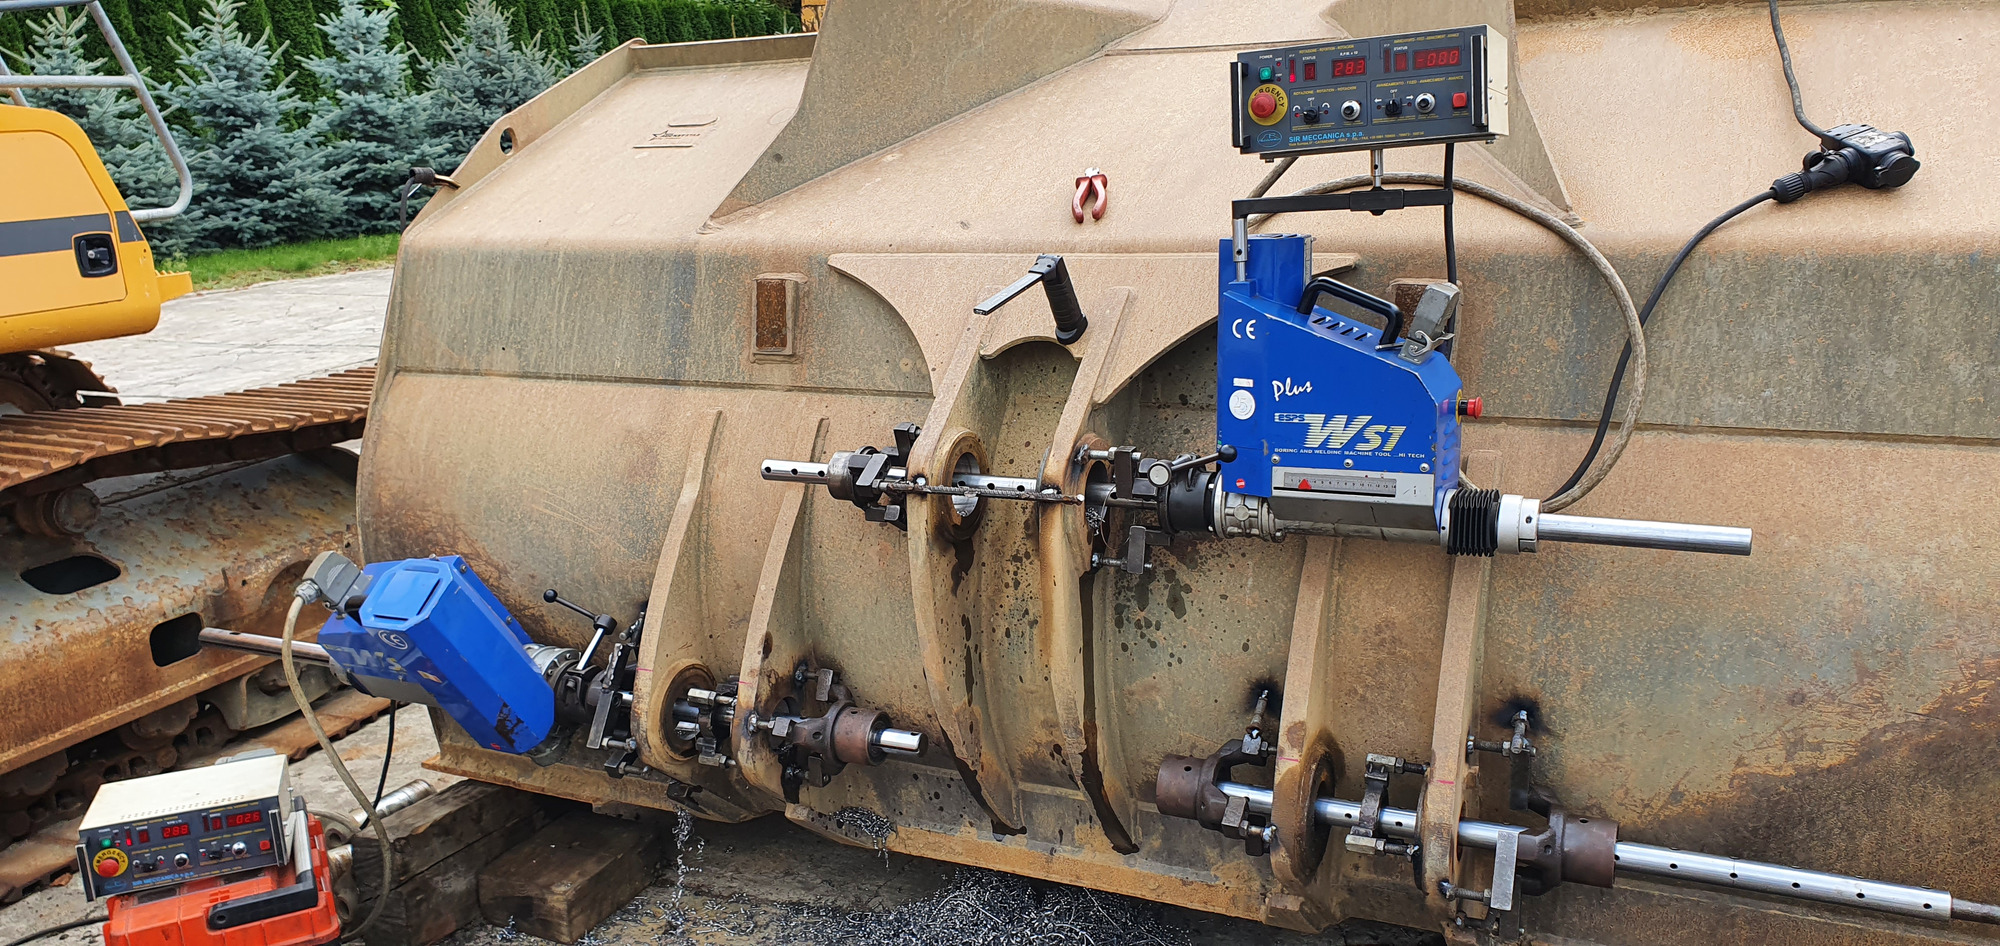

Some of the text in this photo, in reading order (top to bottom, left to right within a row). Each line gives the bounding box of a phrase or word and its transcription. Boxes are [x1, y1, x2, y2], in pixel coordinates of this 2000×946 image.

[1334, 60, 1364, 76] 283
[1302, 132, 1345, 141] MECCANICA
[1232, 318, 1256, 340] CE
[1272, 377, 1312, 402] Plus
[163, 824, 189, 838] 288
